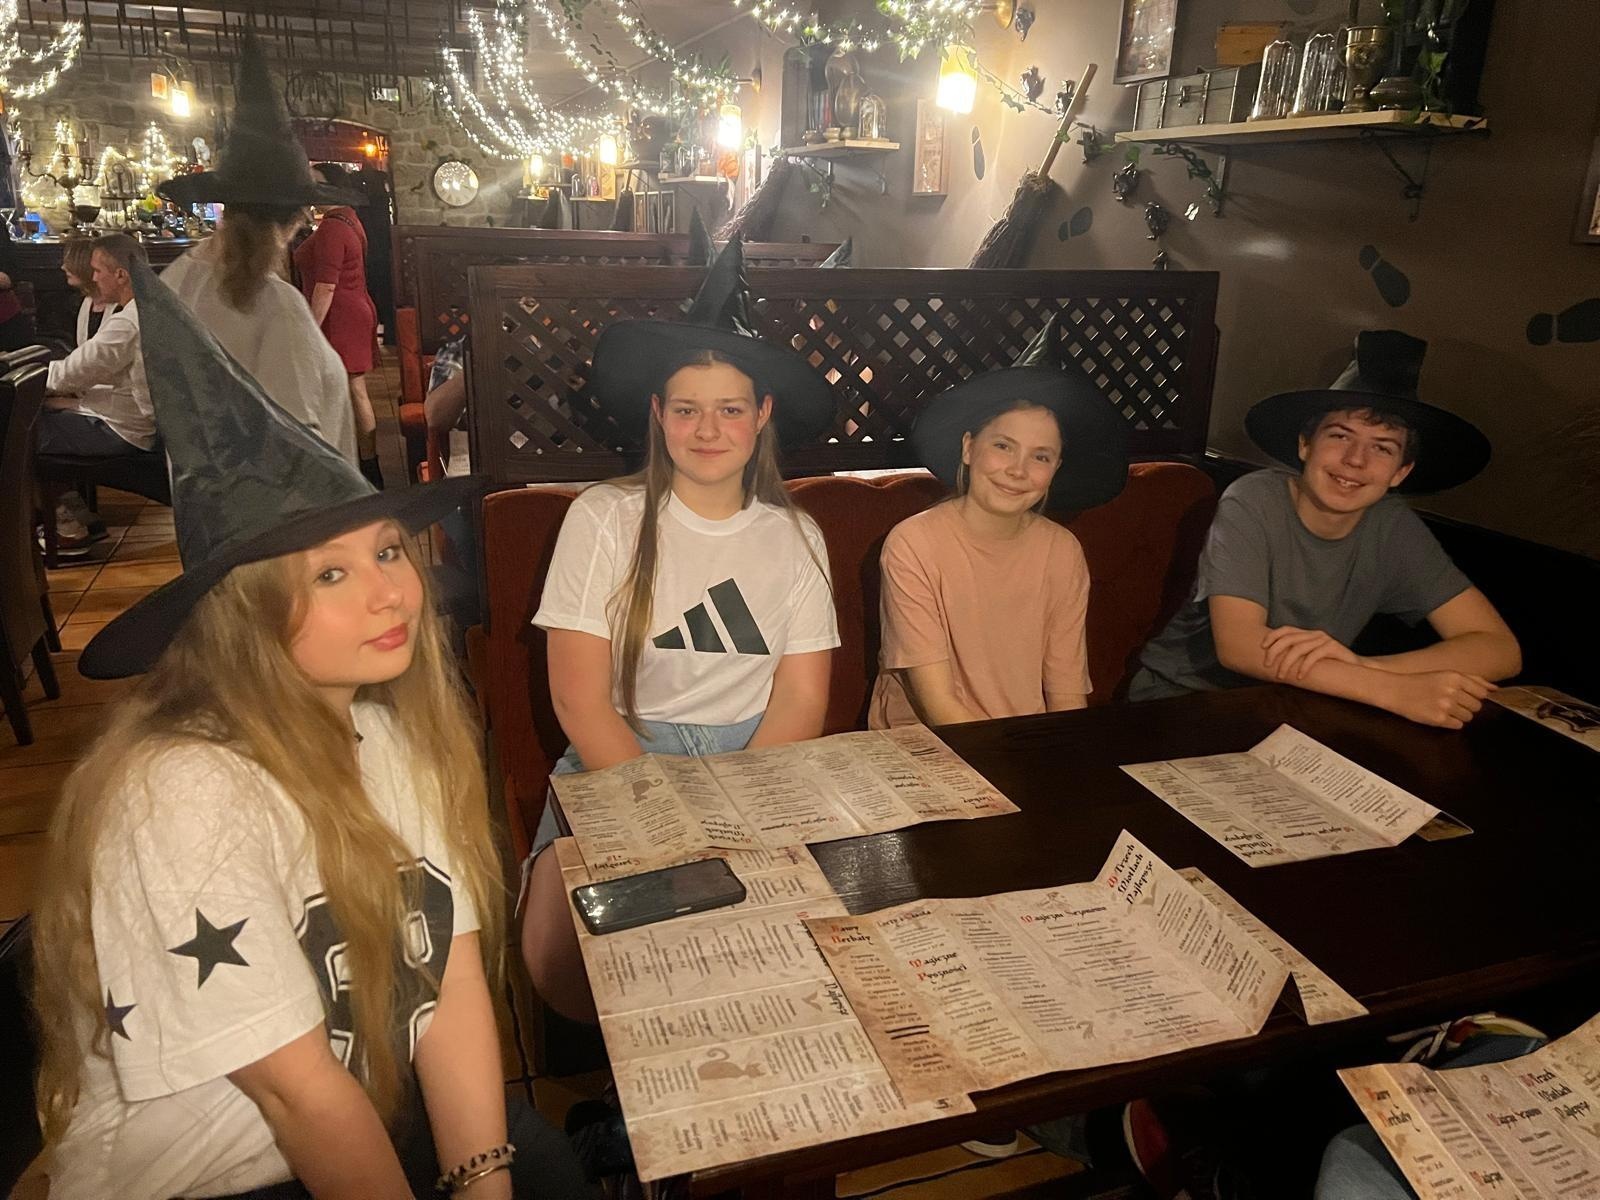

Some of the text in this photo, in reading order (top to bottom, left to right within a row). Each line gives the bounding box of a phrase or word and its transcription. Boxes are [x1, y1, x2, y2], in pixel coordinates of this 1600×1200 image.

[1114, 844, 1135, 873] Trzech
[1125, 860, 1153, 905] Najlepsze
[831, 934, 874, 945] Herbaty
[908, 952, 957, 967] Magiczne
